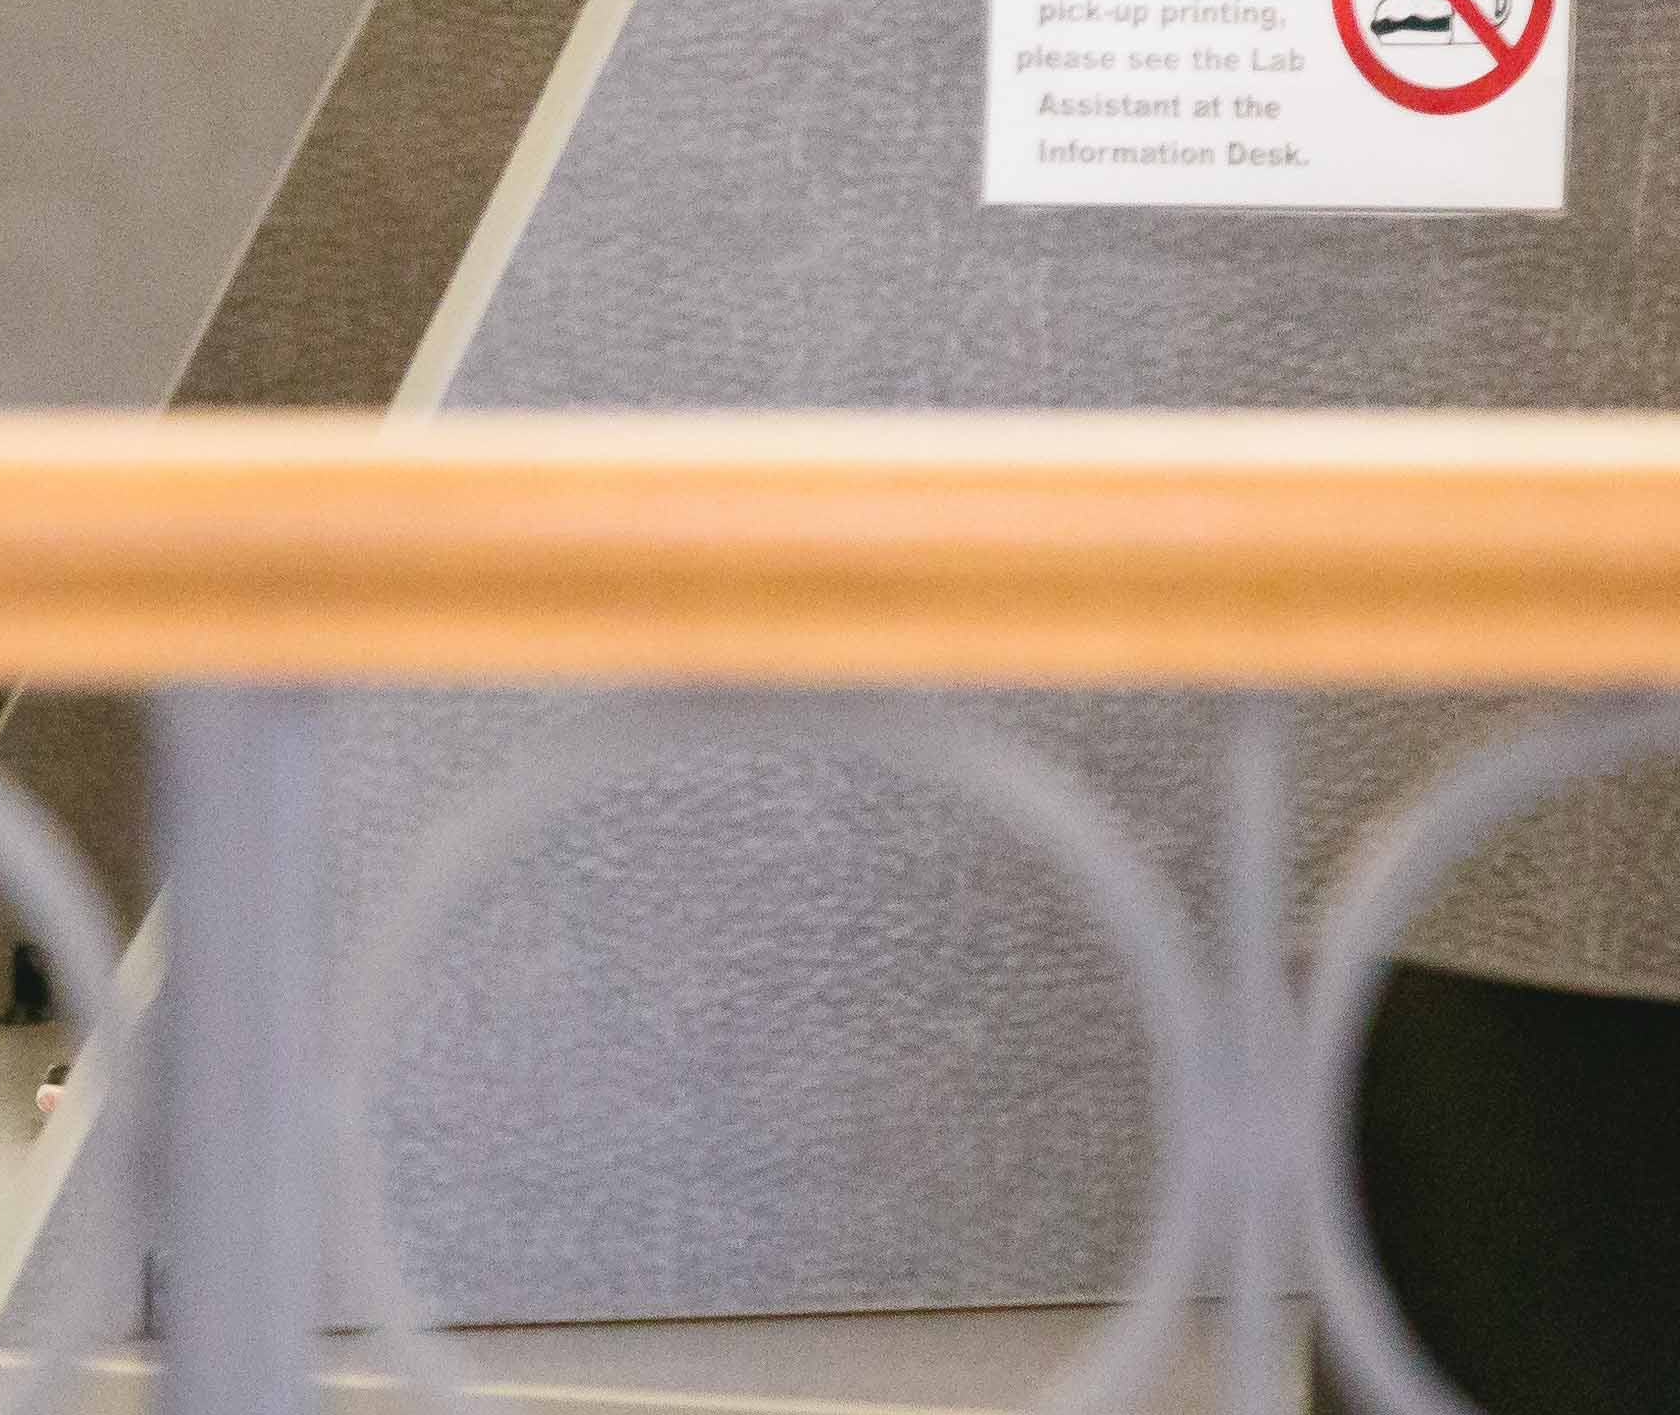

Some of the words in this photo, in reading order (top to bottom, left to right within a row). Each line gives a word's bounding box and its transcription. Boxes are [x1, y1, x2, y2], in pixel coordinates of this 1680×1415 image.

[1039, 0, 1149, 27] pick-up
[1161, 1, 1286, 31] printing,
[1016, 46, 1115, 74] please
[1128, 51, 1180, 71] see
[1193, 47, 1240, 72] the
[1252, 48, 1305, 73] Lab
[1038, 92, 1180, 118] Assistant
[1193, 96, 1223, 118] at
[1233, 95, 1281, 120] the
[1038, 140, 1215, 165] Information
[1227, 141, 1310, 167] Desk.
